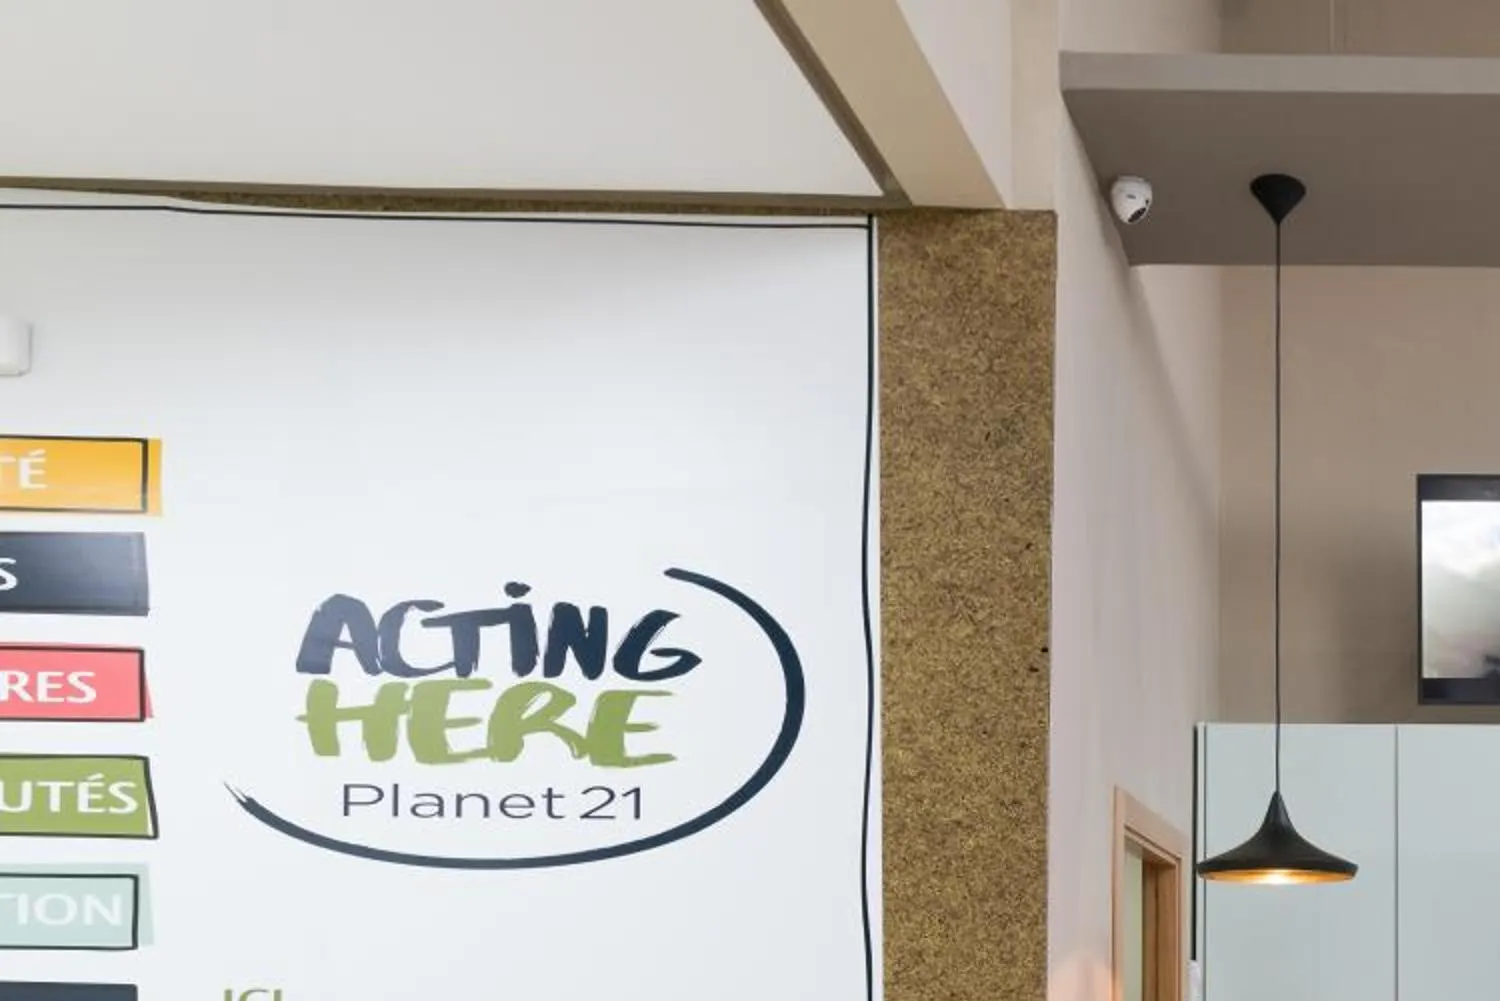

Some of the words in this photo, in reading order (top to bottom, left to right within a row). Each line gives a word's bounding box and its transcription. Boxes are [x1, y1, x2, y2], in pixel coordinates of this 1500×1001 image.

[296, 678, 677, 768] HERE
[343, 783, 565, 819] Planet
[580, 785, 643, 820] 21
